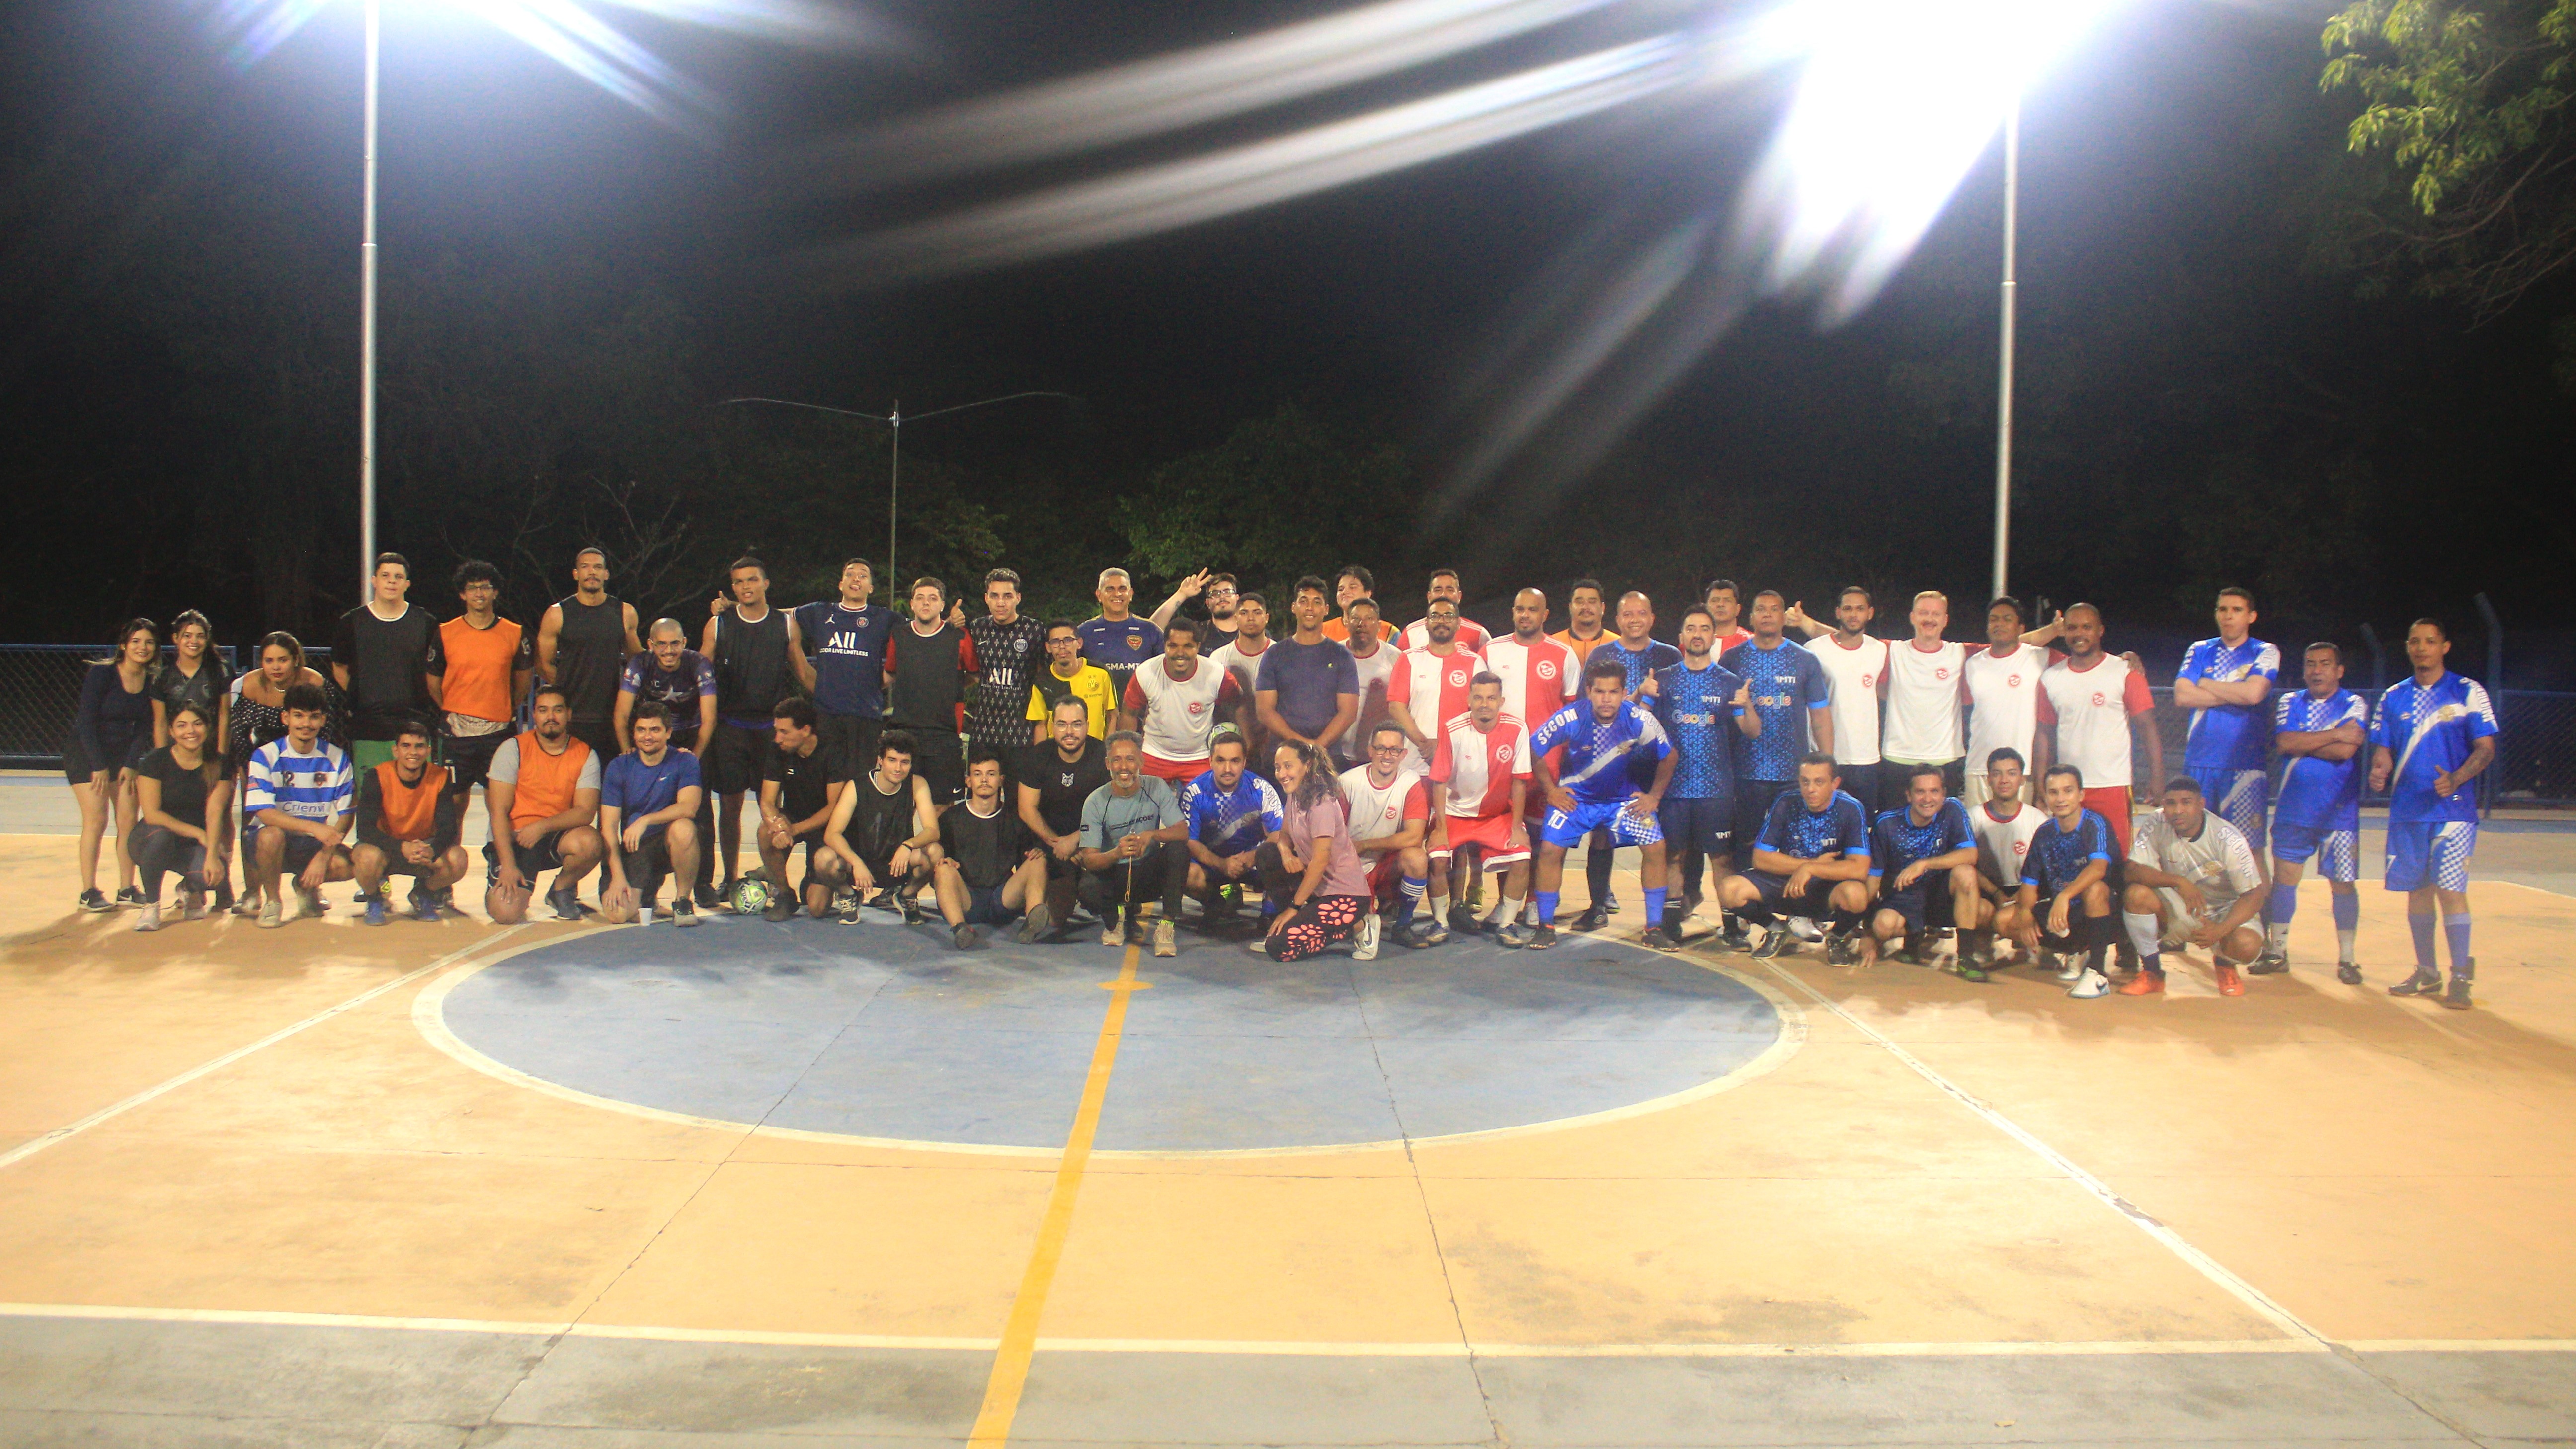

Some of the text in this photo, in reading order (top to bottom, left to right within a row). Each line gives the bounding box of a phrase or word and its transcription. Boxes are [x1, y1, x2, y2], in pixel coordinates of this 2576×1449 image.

[1537, 708, 1578, 745] SECOM
[1672, 709, 1715, 727] Google
[281, 771, 295, 787] 12
[1253, 777, 1284, 819] SECOM
[1547, 809, 1568, 830] 10
